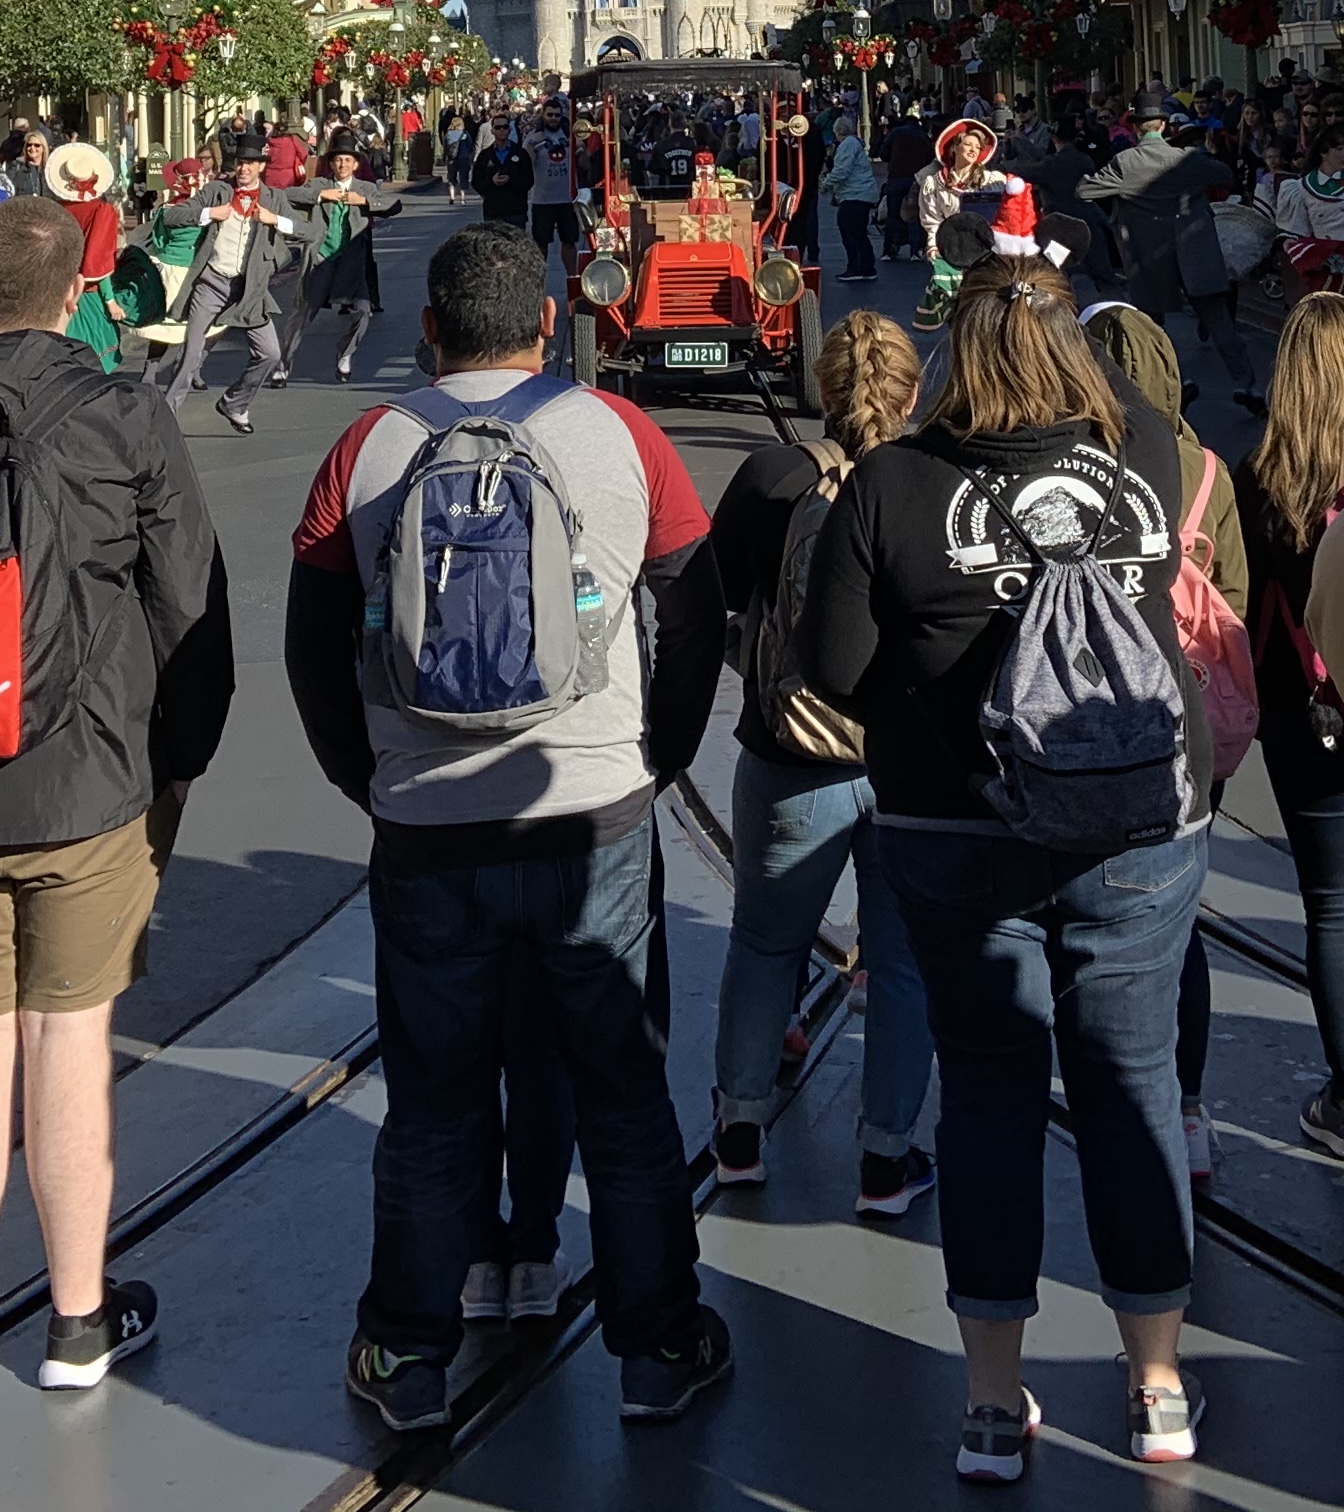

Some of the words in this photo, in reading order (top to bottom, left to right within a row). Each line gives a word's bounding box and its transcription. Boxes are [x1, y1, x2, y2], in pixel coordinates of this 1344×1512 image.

[670, 159, 688, 175] 19
[684, 348, 722, 361] D1218
[990, 475, 1007, 495] OF
[1129, 826, 1167, 840] adidas
